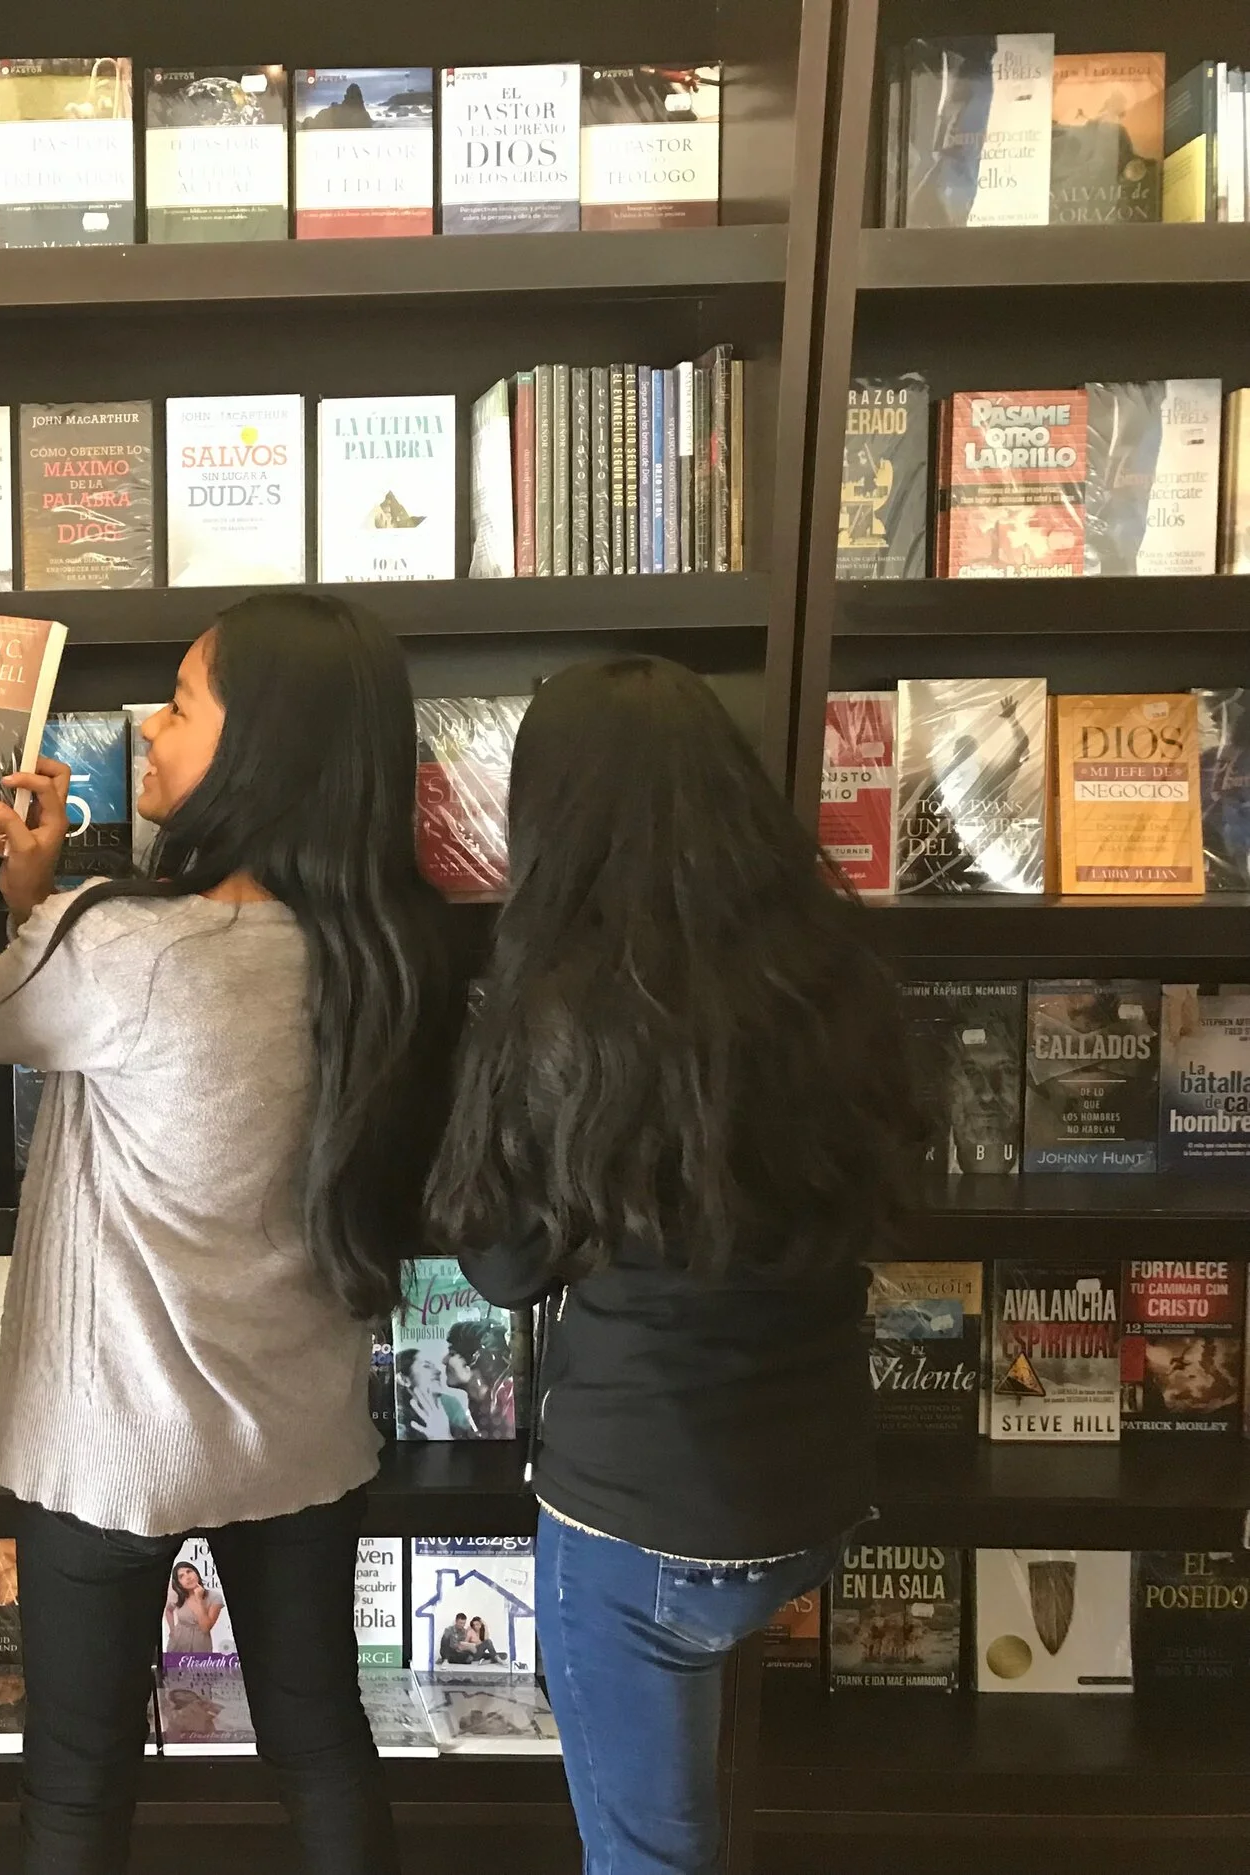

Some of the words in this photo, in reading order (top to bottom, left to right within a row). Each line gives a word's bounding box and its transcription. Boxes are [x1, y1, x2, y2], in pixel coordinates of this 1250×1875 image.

[501, 88, 522, 100] EL
[466, 103, 556, 121] PASTOR
[465, 139, 559, 168] DIOS
[977, 168, 1019, 190] ellos
[612, 373, 623, 385] EL
[626, 373, 637, 385] EL
[640, 381, 650, 407] Seguro
[31, 415, 62, 428] JOHN
[612, 389, 623, 443] EVANGELIO
[626, 389, 637, 443] EVANGELIO
[970, 397, 1071, 428] PÁSAME
[641, 419, 650, 431] los
[641, 431, 650, 456] brazos
[984, 426, 1051, 449] OTRO
[69, 445, 124, 458] OBTENER
[125, 444, 143, 456] LO
[180, 444, 289, 469] SALVOS
[342, 439, 435, 460] PALABRA
[964, 443, 1077, 469] LADRILLO
[43, 457, 131, 478] MÁXIMO
[641, 457, 650, 467] de
[69, 479, 85, 490] DE
[86, 479, 104, 490] LA
[201, 472, 218, 482] SIN
[218, 471, 257, 482] LUGAR
[259, 471, 268, 481] A
[641, 468, 650, 485] Dios
[41, 491, 132, 509] PALABRA
[187, 484, 282, 509] DUDAS
[612, 483, 623, 508] DIOS
[626, 483, 637, 508] DIOS
[1146, 507, 1186, 528] ellos
[57, 522, 124, 544] DIOS
[959, 564, 1007, 578] Charles
[1019, 562, 1073, 577] Swindoll
[5, 638, 23, 660] C.
[1078, 725, 1184, 760] DIOS
[1090, 766, 1109, 777] MI
[1114, 766, 1147, 780] JEFE
[1080, 783, 1184, 799] NEGOCIOS
[1091, 868, 1131, 880] LARRY
[1134, 867, 1178, 880] JULIAN
[1033, 1033, 1151, 1060] CALLADOS
[1188, 1060, 1206, 1076] La
[1179, 1070, 1250, 1094] batalla
[1083, 1099, 1101, 1110] QUE
[1080, 1112, 1121, 1122] HOMBRES
[1081, 1125, 1116, 1134] HABLAN
[1036, 1150, 1098, 1165] JOHNNY
[1102, 1150, 1145, 1165] HUNT
[1130, 1260, 1230, 1280] FORTALECE
[1130, 1283, 1145, 1296] TU
[1148, 1282, 1201, 1296] CAMINAR
[1205, 1282, 1230, 1296] CON
[1002, 1288, 1118, 1322] AVALANCHA
[1147, 1298, 1210, 1318] CRISTO
[868, 1355, 978, 1391] Vidente
[1001, 1415, 1063, 1433] STEVE
[1072, 1415, 1115, 1433] HILL
[842, 1545, 946, 1571] CERDOS
[1184, 1552, 1212, 1577] EL
[842, 1573, 867, 1600] EN
[871, 1573, 895, 1600] LA
[898, 1573, 946, 1600] SALA
[361, 1597, 375, 1606] su
[178, 1655, 228, 1669] Elizabeth
[836, 1675, 864, 1687] FRANK
